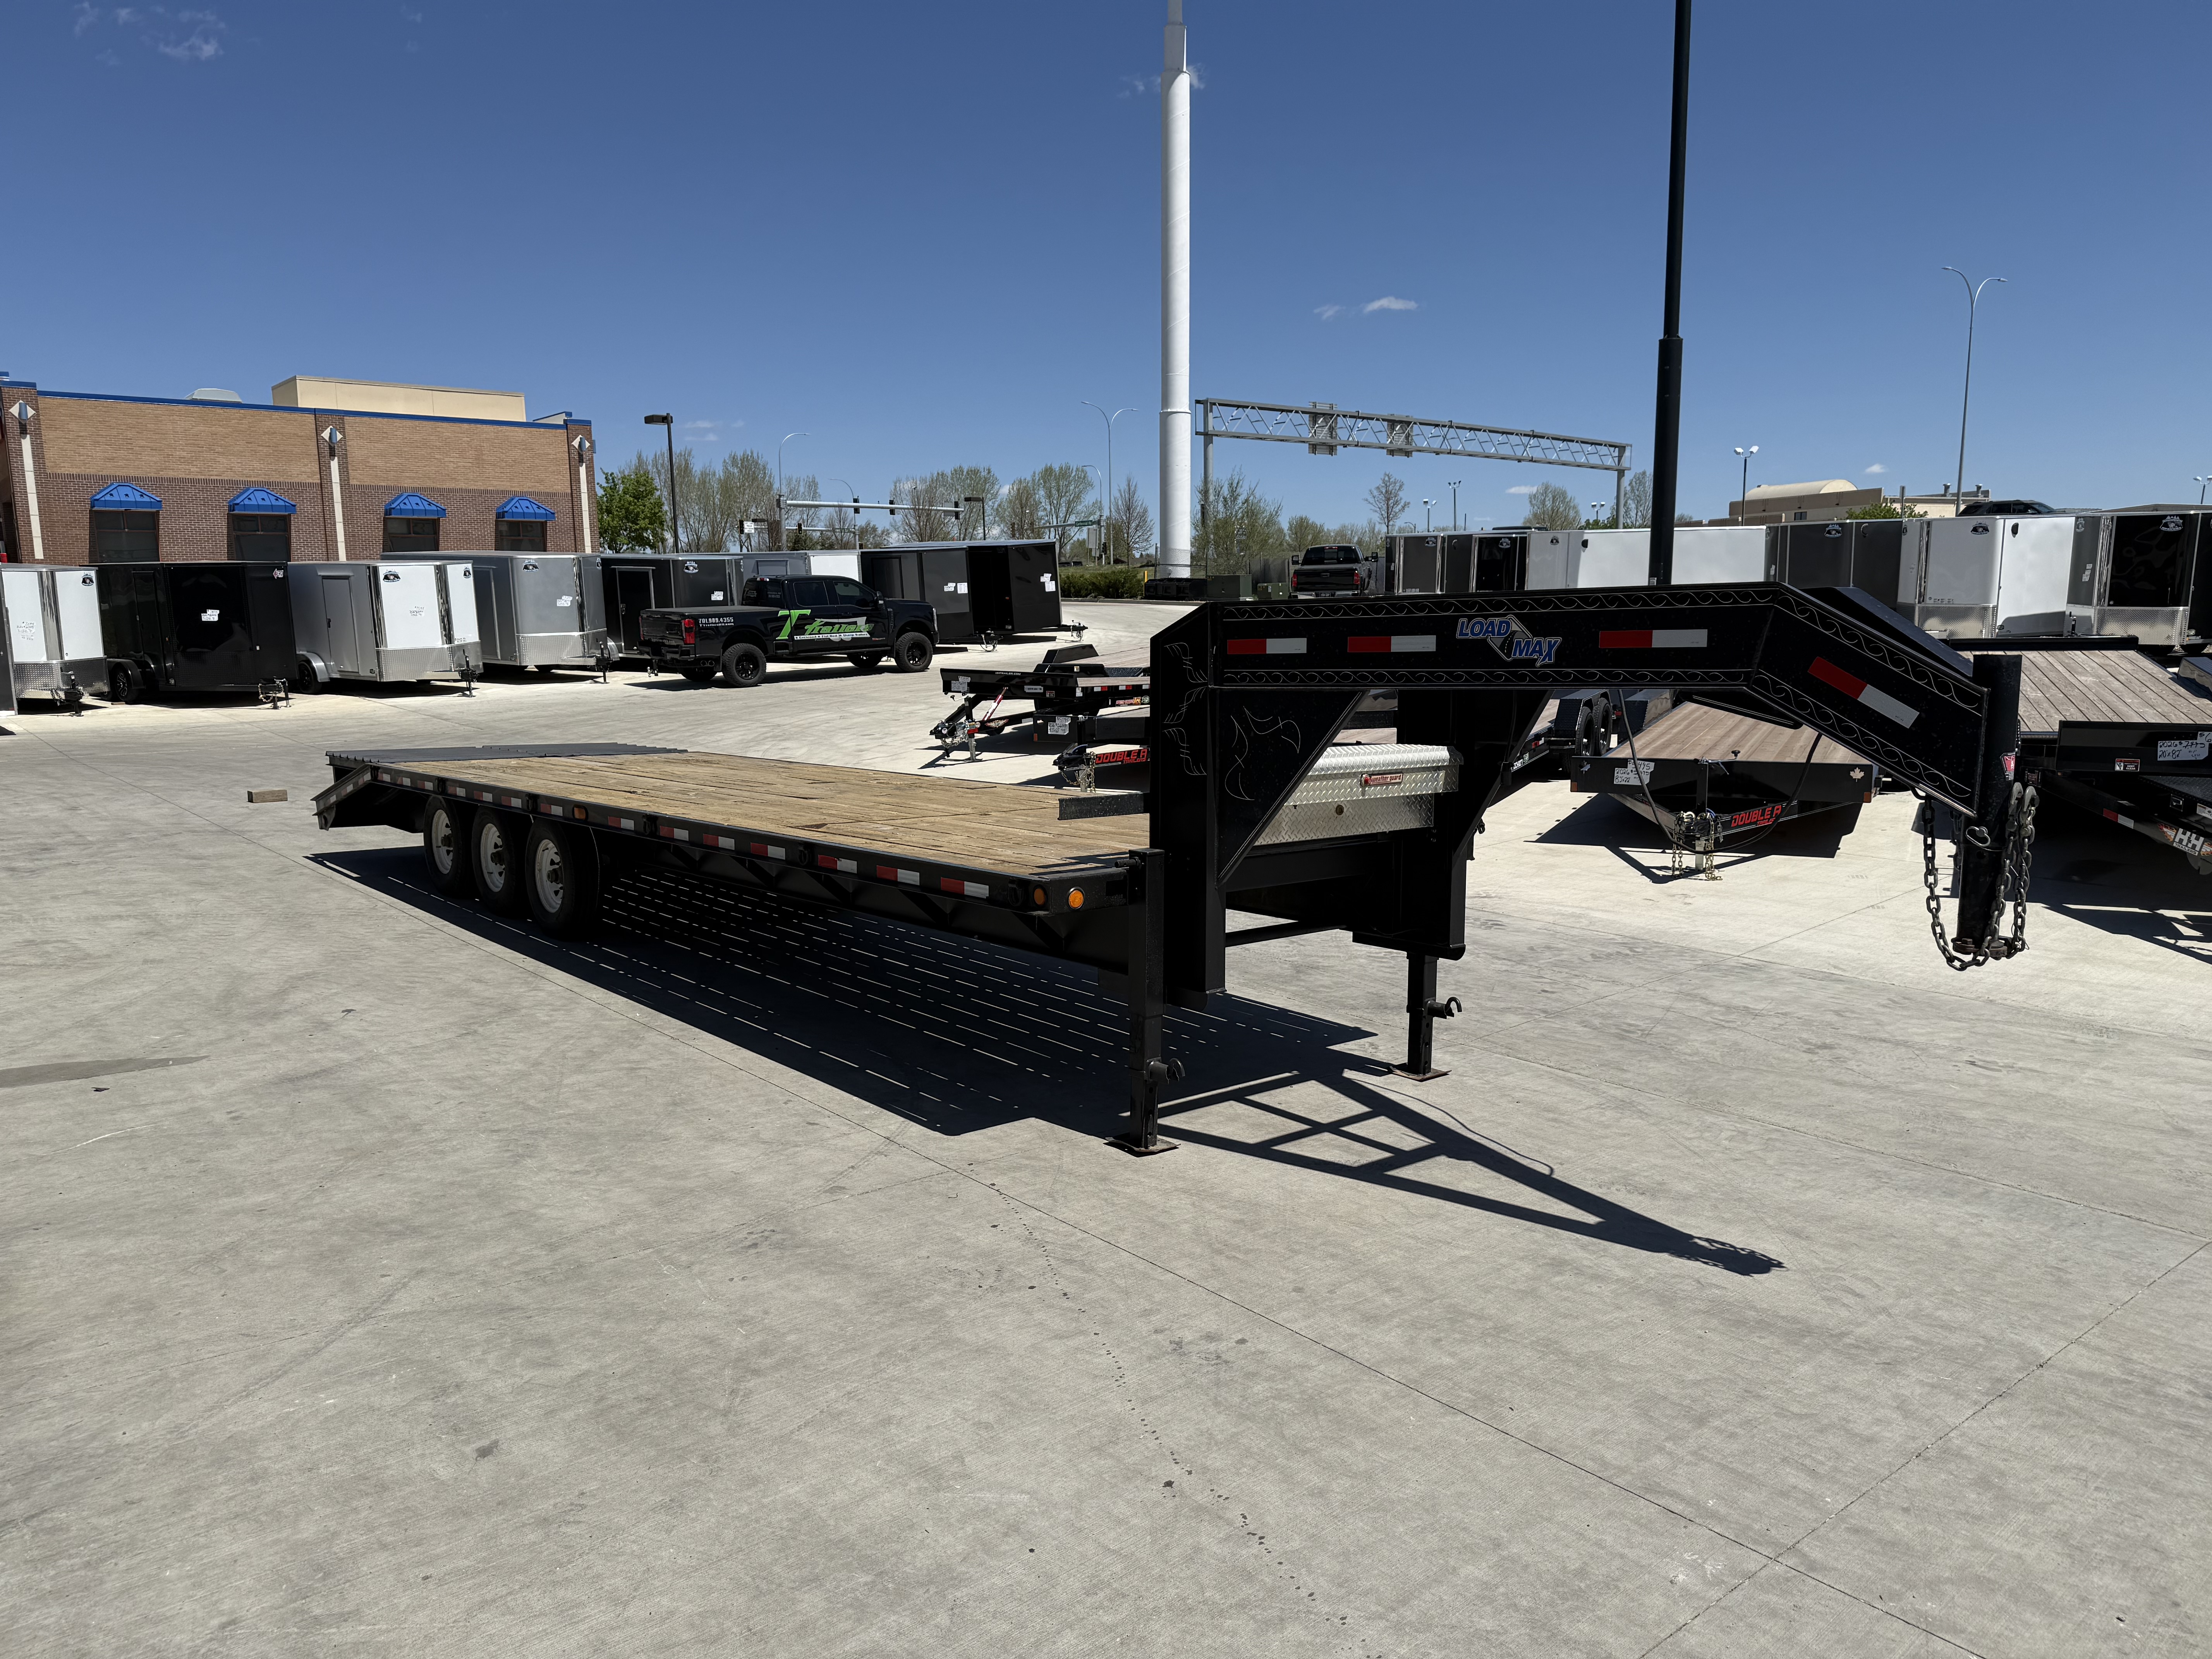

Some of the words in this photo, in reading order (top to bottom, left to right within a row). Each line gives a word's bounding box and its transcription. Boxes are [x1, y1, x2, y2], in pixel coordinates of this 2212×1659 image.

[775, 609, 811, 639] T
[1457, 618, 1512, 638] LOAD
[1511, 638, 1561, 666] MAX
[1096, 750, 1139, 763] DOUBLE
[1140, 749, 1147, 758] A
[1731, 807, 1772, 827] DOUBLE
[1773, 805, 1781, 817] A
[2174, 828, 2204, 851] H&H
[2174, 843, 2197, 855] TRAILERS
